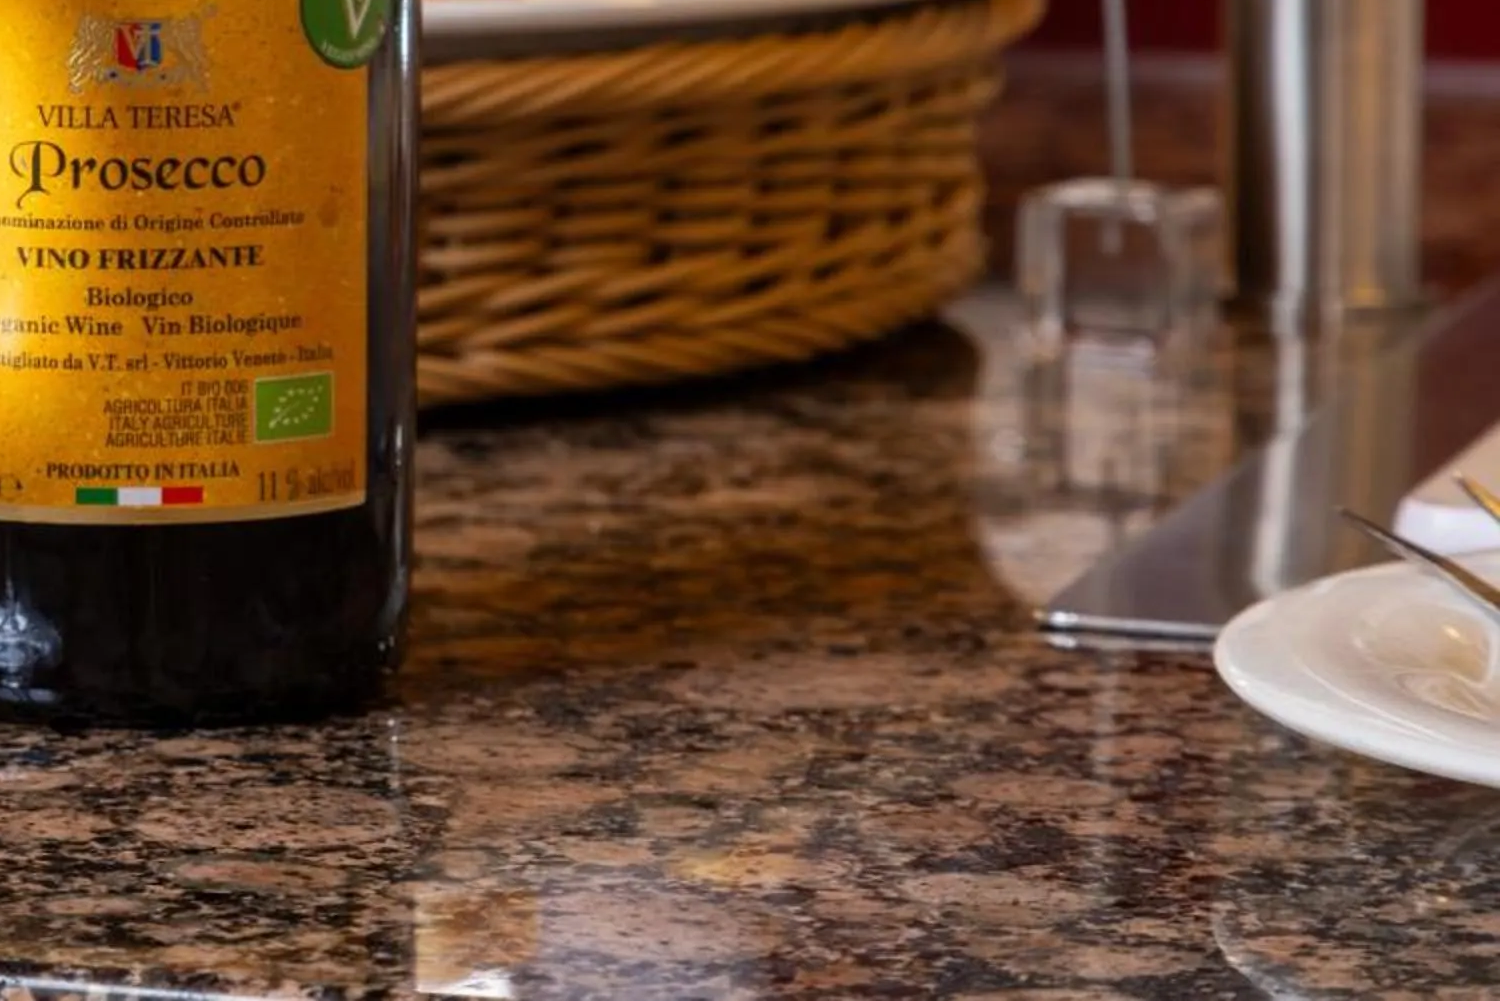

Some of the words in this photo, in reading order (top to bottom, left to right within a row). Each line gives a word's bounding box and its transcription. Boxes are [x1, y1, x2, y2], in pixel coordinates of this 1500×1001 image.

[37, 104, 118, 130] VILLA
[9, 140, 267, 209] Prosecco
[109, 211, 129, 231] di
[134, 212, 204, 235] Origine
[16, 247, 91, 270] VINO
[97, 245, 265, 271] FRIZZANTE
[85, 287, 194, 311] Biologico
[66, 313, 123, 335] Wine
[141, 314, 182, 335] Vin
[189, 311, 303, 337] Biologique
[62, 352, 84, 370] da
[163, 349, 228, 371] Vittorio
[231, 346, 287, 369] Veneto
[103, 398, 203, 416] AGRICOLTURA
[205, 396, 250, 413] ITALIA
[109, 415, 150, 431] ITALY
[152, 413, 249, 431] AGRICULTURE
[104, 430, 204, 448] AGRICULTURE
[207, 428, 249, 446] ITALIE
[46, 461, 149, 482] PRODOTTO
[155, 462, 175, 481] IN
[178, 460, 240, 480] ITALIA
